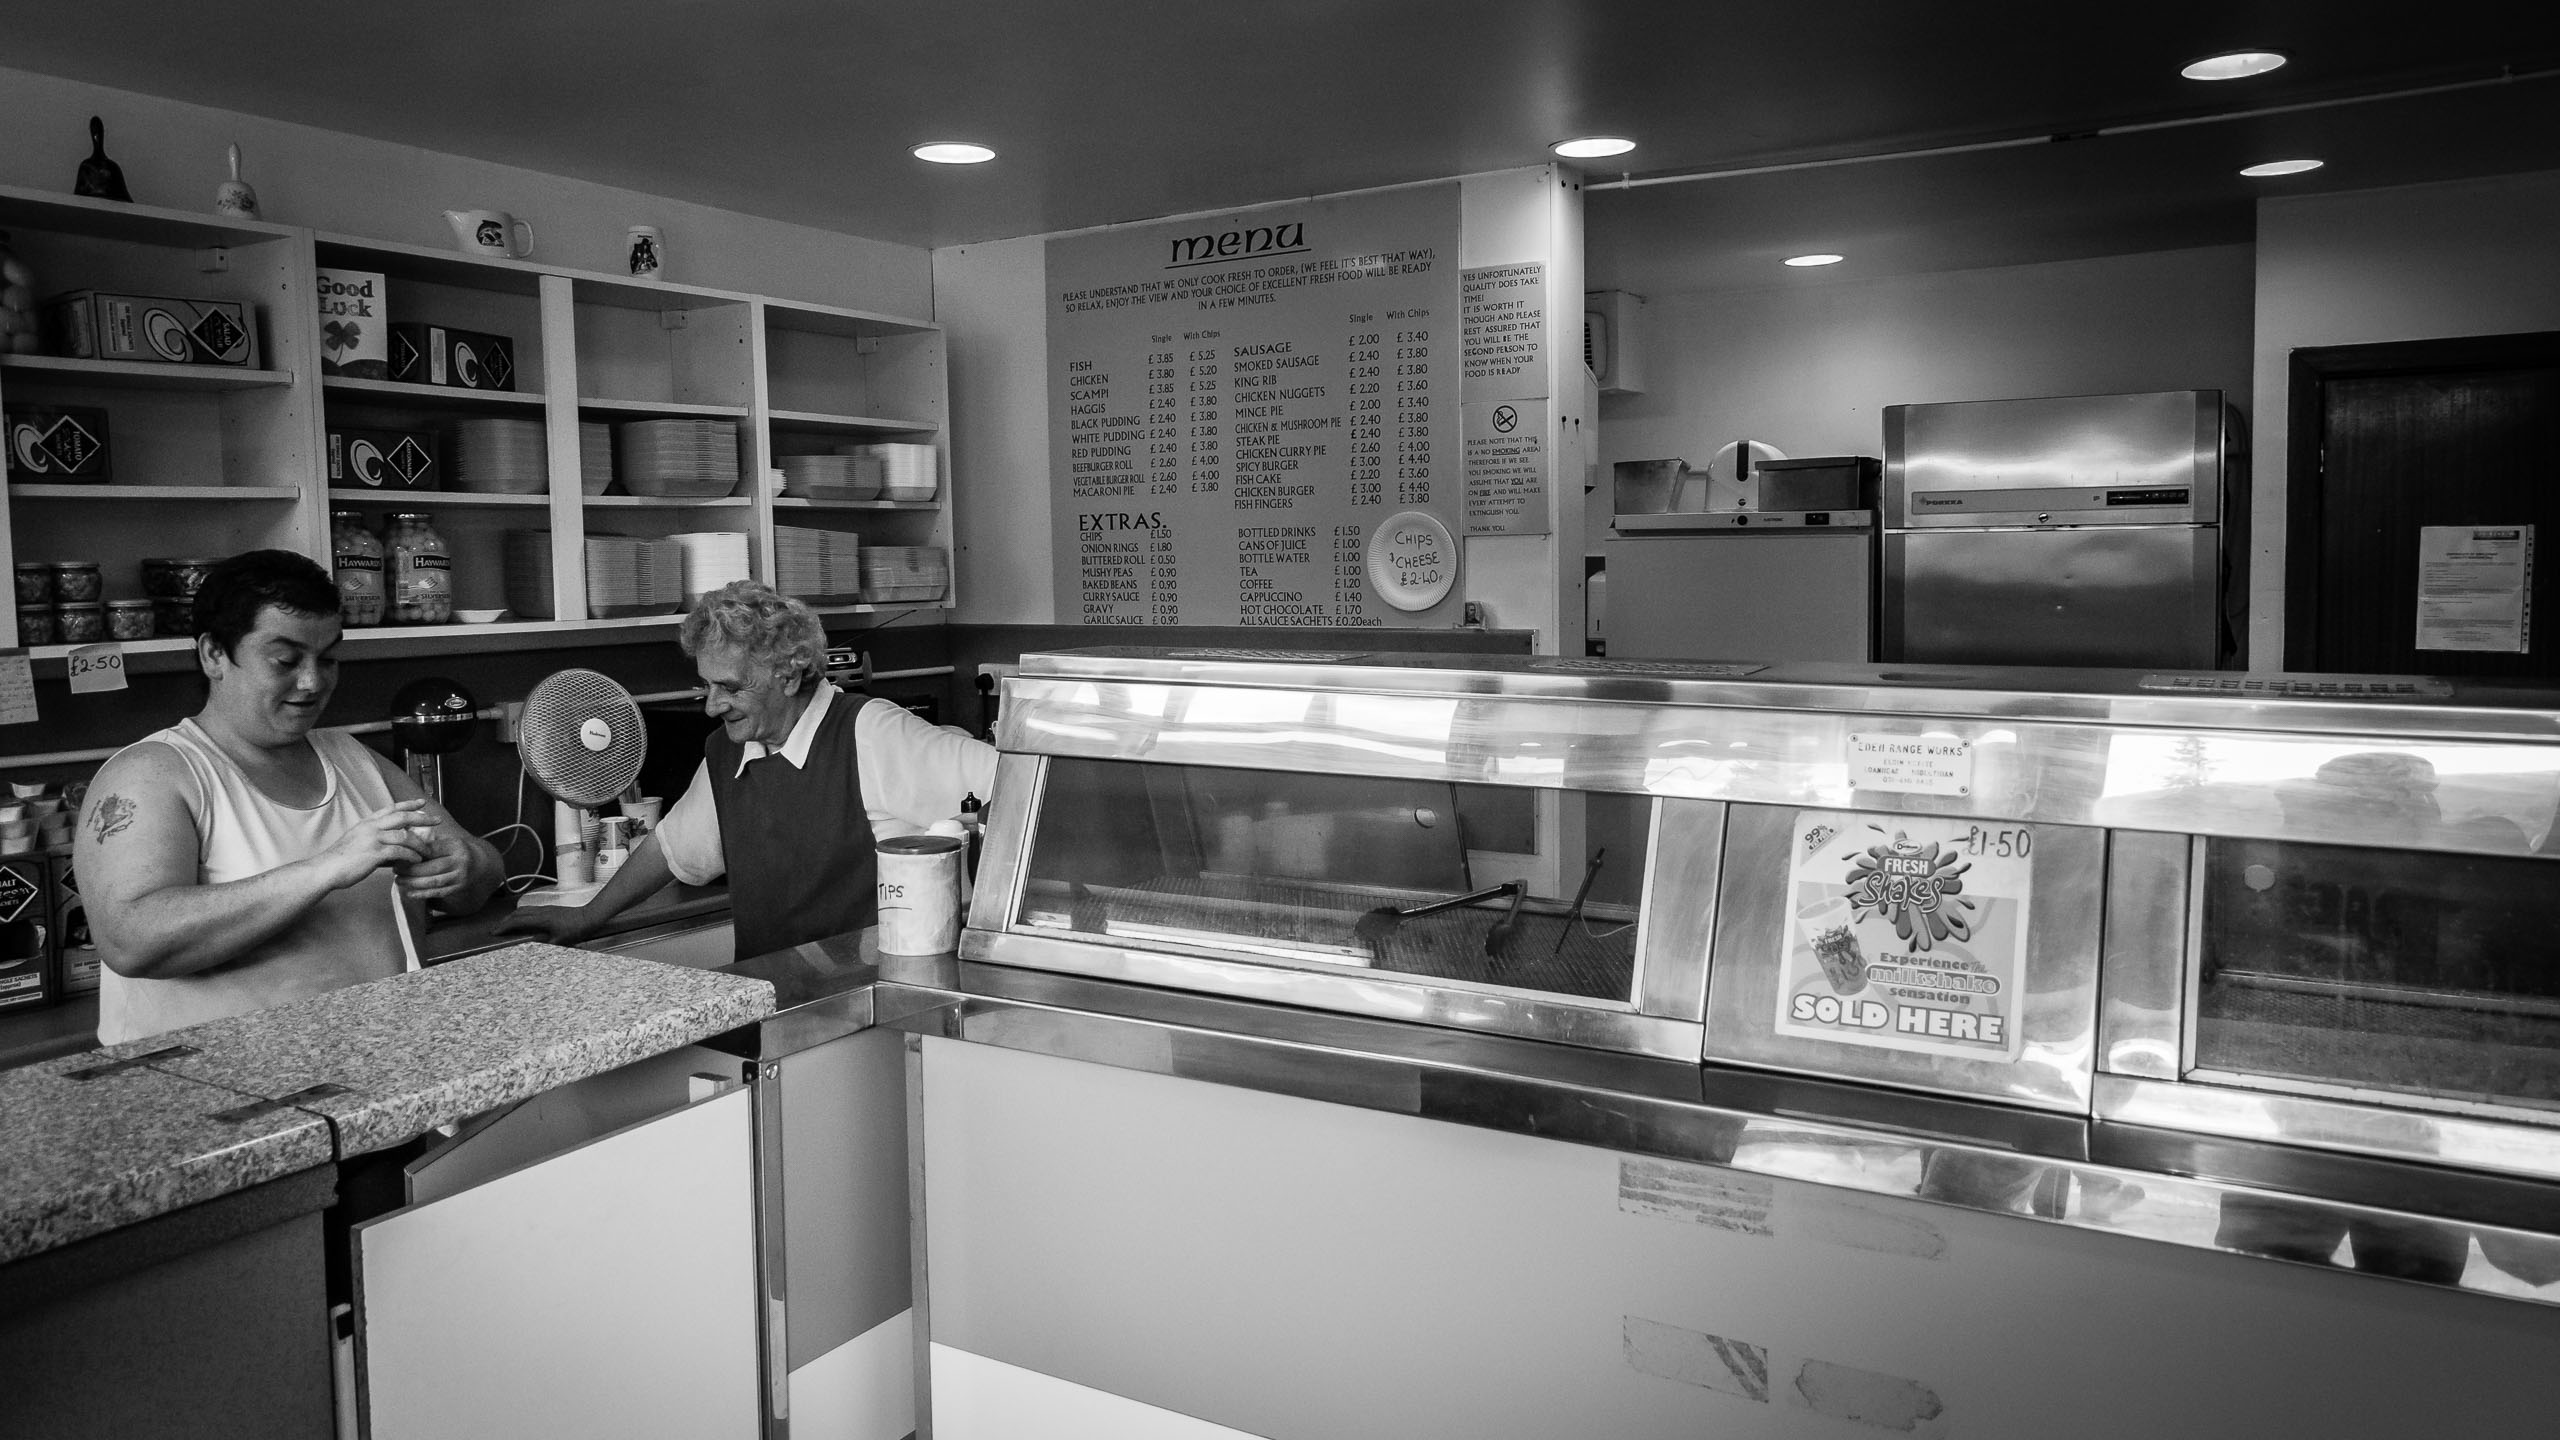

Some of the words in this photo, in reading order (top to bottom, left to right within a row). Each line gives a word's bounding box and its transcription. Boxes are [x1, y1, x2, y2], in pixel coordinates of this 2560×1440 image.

[1171, 222, 1304, 263] menu
[1063, 290, 1087, 302] PLEASE
[1089, 285, 1139, 298] UNDERSTAND
[1141, 282, 1161, 291] THAT
[1164, 280, 1175, 288] WE
[1178, 277, 1199, 288] ONLY
[1201, 274, 1225, 285] COOK
[1228, 271, 1251, 282] FRESH
[1254, 269, 1265, 278] TO
[1268, 266, 1298, 278] ORDER,
[1320, 260, 1338, 271] FEEL
[1359, 255, 1378, 266] BEST
[1382, 252, 1405, 263] THAT
[1463, 273, 1475, 281] YES
[1478, 266, 1541, 280] UNFORTUNATELY
[317, 276, 374, 298] Good
[1066, 304, 1075, 313] SO
[1077, 300, 1103, 312] RELAX,
[1106, 299, 1129, 308] ENJOY
[1132, 294, 1146, 305] THE
[1149, 293, 1168, 304] VIEW
[1170, 290, 1189, 300] AND
[1191, 287, 1213, 298] YOUR
[1215, 284, 1245, 295] CHOICE
[1249, 282, 1260, 291] OF
[1262, 275, 1306, 290] EXCELLENT
[1310, 272, 1334, 284] FRESH
[1338, 269, 1362, 281] FOOD
[1366, 267, 1385, 277] WILL
[1389, 266, 1398, 275] BE
[1402, 262, 1432, 274] READY
[1463, 282, 1495, 292] QUALITY
[1499, 279, 1518, 288] DOES
[1521, 277, 1539, 285] TAKE
[318, 297, 372, 317] Luck
[1198, 301, 1206, 310] IN
[1210, 300, 1216, 309] A
[1219, 298, 1235, 308] FEW
[1237, 293, 1276, 308] MINUTES.
[1349, 313, 1373, 323] Single
[1386, 311, 1405, 319] With
[1407, 308, 1429, 318] Chips
[1183, 332, 1199, 340] With
[1201, 330, 1220, 339] Chips
[1234, 342, 1292, 357] SAUSAGE
[1464, 346, 1494, 356] SECOND
[1496, 344, 1525, 353] PERSON
[1527, 343, 1537, 351] TO
[1070, 361, 1092, 371] FISH
[1234, 359, 1273, 372] SMOKED
[1275, 355, 1319, 368] SAUSAGE
[1464, 358, 1488, 367] KNOW
[1490, 357, 1511, 365] WHEN
[1514, 355, 1534, 363] YOUR
[1465, 370, 1486, 378] FOOD
[1497, 367, 1521, 375] READY
[1070, 374, 1108, 386] CHICKEN
[1234, 376, 1259, 388] KING
[1263, 375, 1277, 385] RIB
[1070, 389, 1109, 400] SCAMPI
[1235, 390, 1276, 403] CHICKEN
[1280, 386, 1325, 400] NUGGETS
[1071, 404, 1105, 415] HAGGIS
[1235, 406, 1266, 418] MINCE
[1271, 405, 1283, 415] PIE
[1071, 419, 1098, 429] BLACK
[1101, 415, 1140, 427] PUDDING
[1235, 422, 1268, 433] CHICKEN
[1281, 418, 1328, 430] MUSHROOM
[1331, 417, 1341, 427] PIE
[1072, 433, 1099, 444] WHITE
[1103, 430, 1145, 442] PUDDING
[1236, 436, 1265, 446] STEAK
[1267, 434, 1280, 445] PIE
[73, 431, 83, 460] TOMATO
[1072, 449, 1088, 458] RED
[1091, 445, 1131, 457] PUDDING
[1236, 447, 1277, 459] CHICKEN
[1279, 445, 1312, 457] CURRY
[1314, 444, 1326, 455] PIE
[1236, 462, 1260, 472] SPICY
[1262, 460, 1299, 471] BURGER
[1235, 475, 1254, 485] FISH
[1256, 473, 1281, 483] CAKE
[1073, 486, 1121, 497] MACARONI
[1123, 486, 1135, 495] PIE
[1235, 486, 1277, 497] CHICKEN
[1278, 485, 1315, 496] BURGER
[1235, 499, 1253, 509] FISH
[1255, 498, 1293, 508] FINGERS
[1080, 532, 1102, 541] CHIPS
[1238, 528, 1279, 538] BOTTLED
[1282, 527, 1315, 537] DRINKS
[1238, 541, 1265, 551] CANS
[1266, 541, 1279, 550] OF
[1280, 540, 1307, 552] JUICE
[1394, 530, 1433, 550] CHIPS
[1082, 543, 1112, 553] ONION
[1114, 543, 1139, 552] RINGS
[1082, 555, 1122, 565] BUTTERED
[1124, 555, 1145, 564] ROLL
[1239, 553, 1276, 563] BOTTLE
[1277, 552, 1310, 562] WATER
[1395, 551, 1440, 569] CHEESE
[1083, 568, 1112, 577] MUSHY
[1114, 568, 1133, 577] PEAS
[1240, 566, 1258, 576] TEA
[1083, 580, 1109, 589] BAKED
[1111, 580, 1137, 589] BEANS
[1240, 579, 1273, 589] COFFEE
[1083, 592, 1110, 601] CURRY
[1112, 592, 1140, 601] SAUCE
[1240, 592, 1302, 602] CAPPUCCINO
[1083, 604, 1114, 613] GRAVY
[1240, 605, 1261, 615] HOT
[1263, 604, 1324, 614] CHOCOLATE
[1084, 616, 1114, 624] GARLIC
[1116, 615, 1143, 624] SAUCE
[1240, 616, 1258, 626] ALL
[1259, 616, 1289, 626] SAUCE
[1291, 615, 1332, 626] SACHETS
[1889, 744, 1922, 754] RANGE
[1928, 746, 1962, 756] WORKS
[1884, 858, 1929, 875] FRESH
[879, 883, 904, 900] TIPS
[1858, 872, 1944, 914] Shakes
[1880, 952, 1969, 972] Experience
[1870, 967, 2000, 995] milkshake
[1888, 987, 1970, 1005] sensation
[1791, 993, 1889, 1028] SOLD
[1896, 1004, 2004, 1044] HERE
